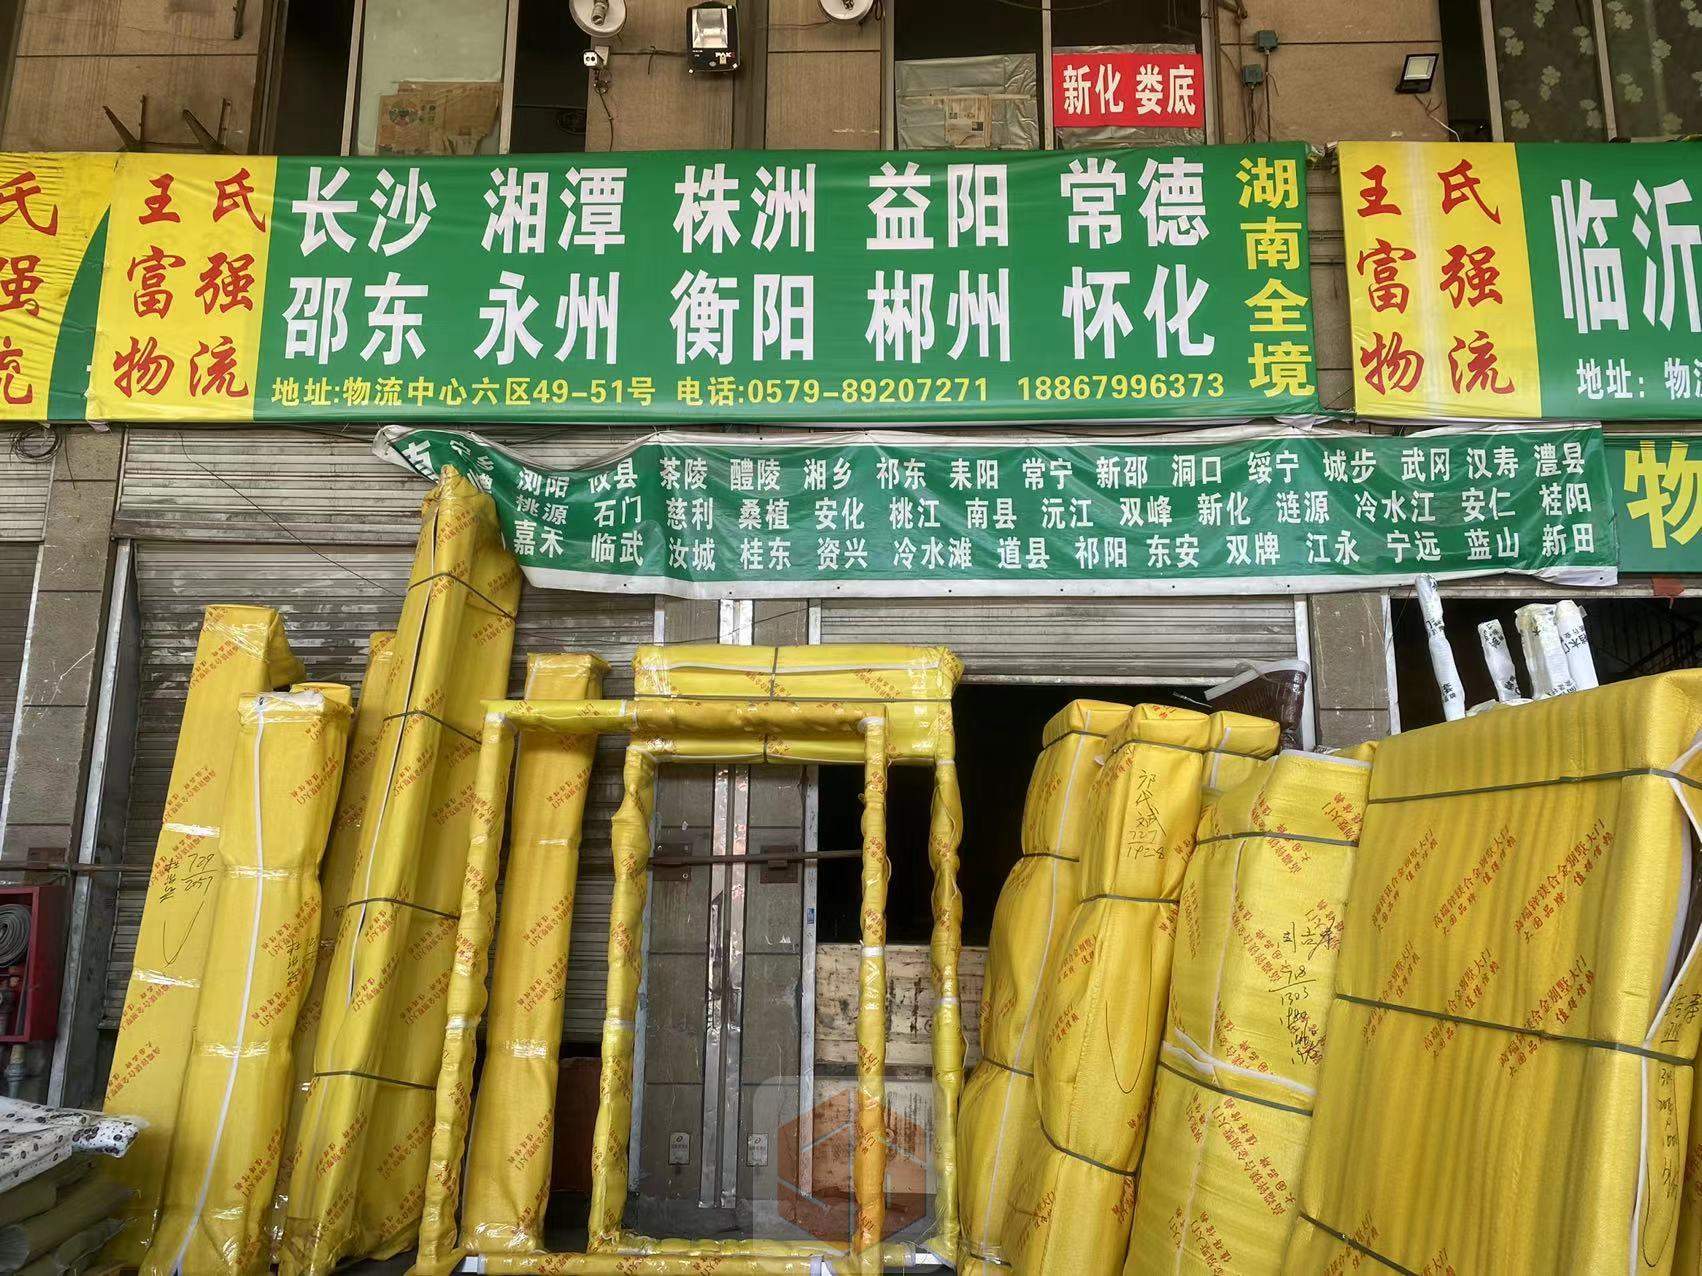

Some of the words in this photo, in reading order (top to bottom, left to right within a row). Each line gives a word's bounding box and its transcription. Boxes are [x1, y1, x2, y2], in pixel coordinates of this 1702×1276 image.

[1062, 64, 1124, 115] 新化
[1136, 64, 1195, 115] 娄底
[137, 167, 266, 233] 王氏
[291, 166, 437, 257] 长沙
[481, 166, 628, 255] 湘潭
[673, 163, 816, 254] 株洲
[866, 161, 1009, 251] 益阳
[1060, 156, 1210, 250] 常德
[1357, 158, 1501, 225] 王氏
[127, 245, 256, 320] 富强
[1236, 157, 1317, 399] 湖南全境
[1356, 237, 1503, 315] 富强
[282, 271, 429, 366] 邵东
[474, 270, 620, 366] 永州
[669, 269, 814, 366] 衡阳
[866, 267, 1011, 364] 郴州
[1062, 263, 1215, 360] 怀化
[112, 336, 250, 400] 物流
[1018, 373, 1224, 401] 18867996373
[1359, 331, 1515, 396] 物流
[660, 455, 708, 494] 茶陵
[727, 458, 784, 494] 醴陵
[803, 457, 851, 490] 湘乡
[876, 455, 926, 491] 祁东
[950, 458, 999, 490] 耒阳
[1023, 457, 1072, 490] 常宁
[1094, 453, 1148, 489] 新邵
[1172, 455, 1221, 487] 洞口
[1248, 448, 1299, 486] 绥宁
[1323, 448, 1376, 483] 城步
[1401, 447, 1450, 482] 武冈
[1467, 446, 1518, 479] 汉寿
[1534, 442, 1585, 477] 澧县
[1623, 441, 1702, 548] 物
[515, 494, 568, 525] 桃源
[594, 496, 641, 527] 石门
[666, 496, 716, 532] 慈利
[736, 496, 790, 532] 桑植
[815, 497, 865, 532] 安化
[888, 496, 940, 531] 桃江
[964, 497, 1017, 532] 南县
[1041, 497, 1095, 529] 沅江
[1117, 496, 1172, 527] 双峰
[1198, 492, 1251, 528] 新化
[1276, 491, 1330, 524] 涟源
[1355, 490, 1435, 523] 冷水江
[1462, 487, 1515, 522] 安仁
[1539, 483, 1592, 515] 桂阳
[514, 519, 564, 558] 嘉禾
[591, 530, 644, 568] 临武
[669, 537, 716, 574] 汝城
[738, 537, 793, 574] 桂东
[817, 537, 869, 572] 资兴
[892, 537, 974, 571] 冷水滩
[996, 537, 1050, 570] 道县
[1075, 536, 1127, 569] 祁阳
[1147, 534, 1199, 568] 东安
[1226, 532, 1280, 567] 双牌
[1306, 530, 1360, 565] 江永
[1386, 530, 1441, 563] 宁远
[1465, 527, 1519, 560] 蓝山
[1542, 523, 1594, 557] 新田
